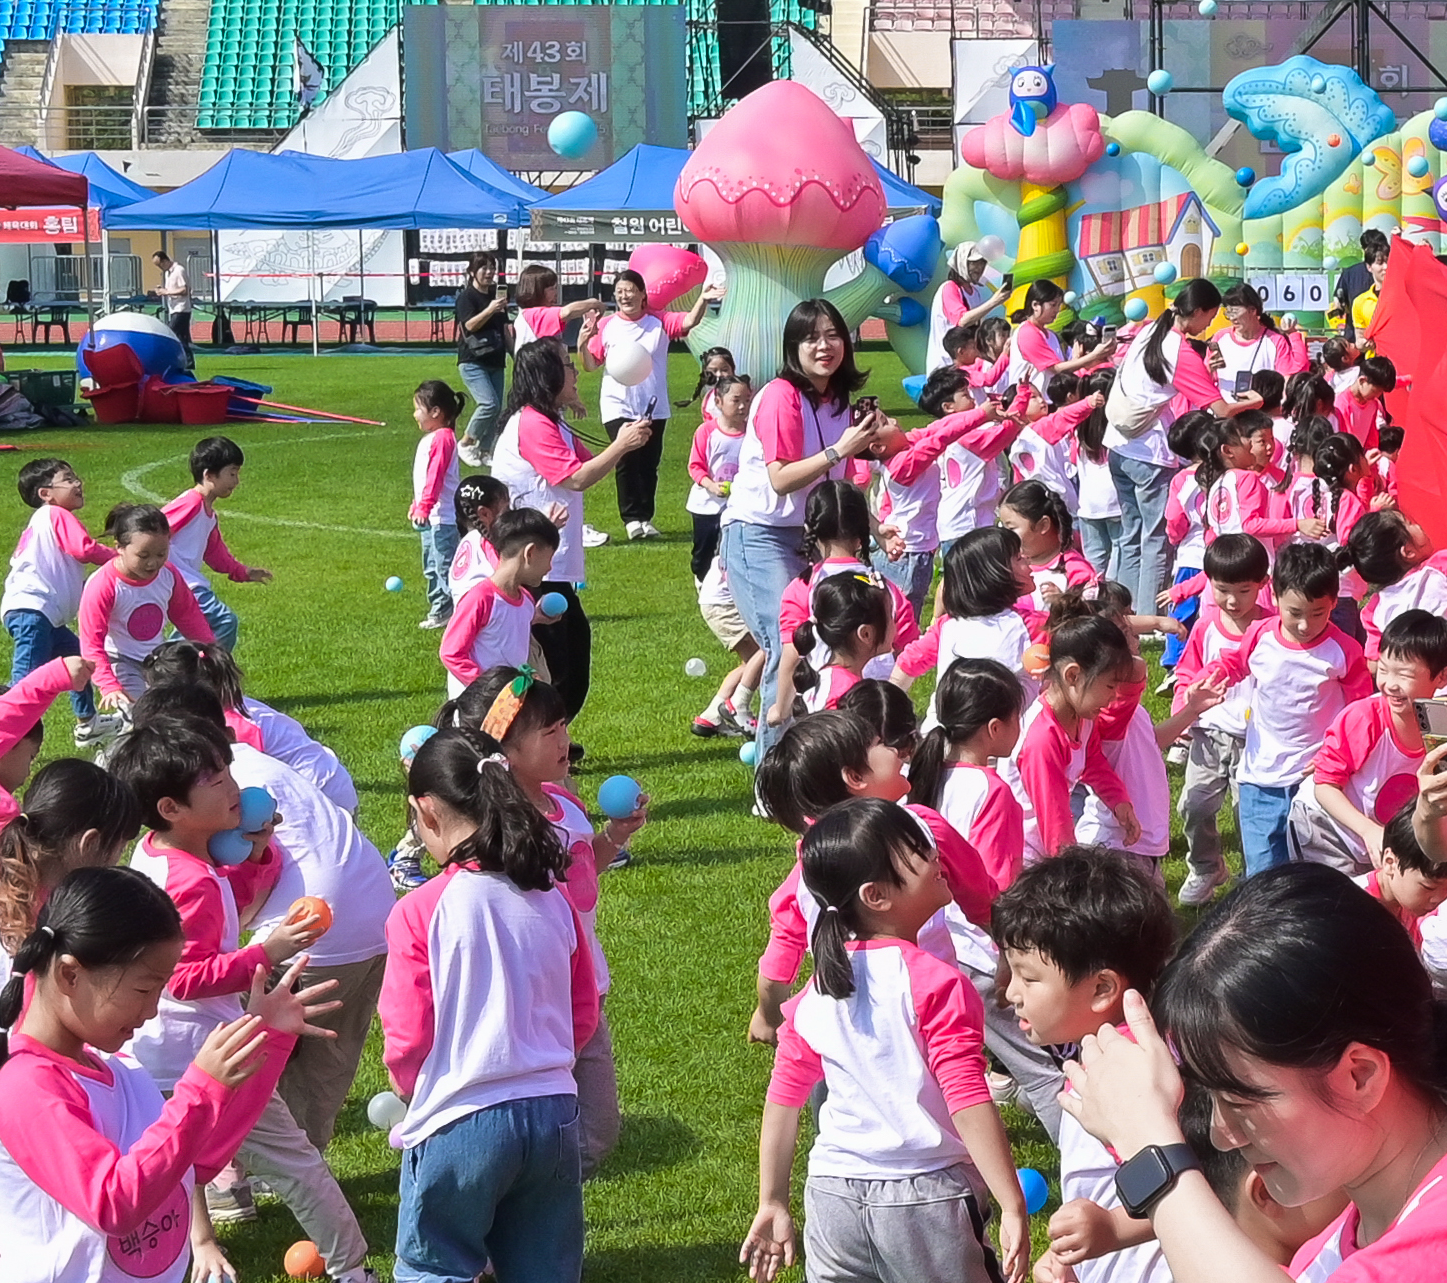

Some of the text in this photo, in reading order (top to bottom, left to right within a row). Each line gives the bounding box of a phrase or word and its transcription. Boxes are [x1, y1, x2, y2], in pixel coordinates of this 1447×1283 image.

[501, 40, 587, 64] 제43회
[482, 71, 609, 114] 태봉제
[43, 215, 78, 235] 홍팀
[610, 216, 645, 235] 철원
[118, 1209, 181, 1258] 백승아
